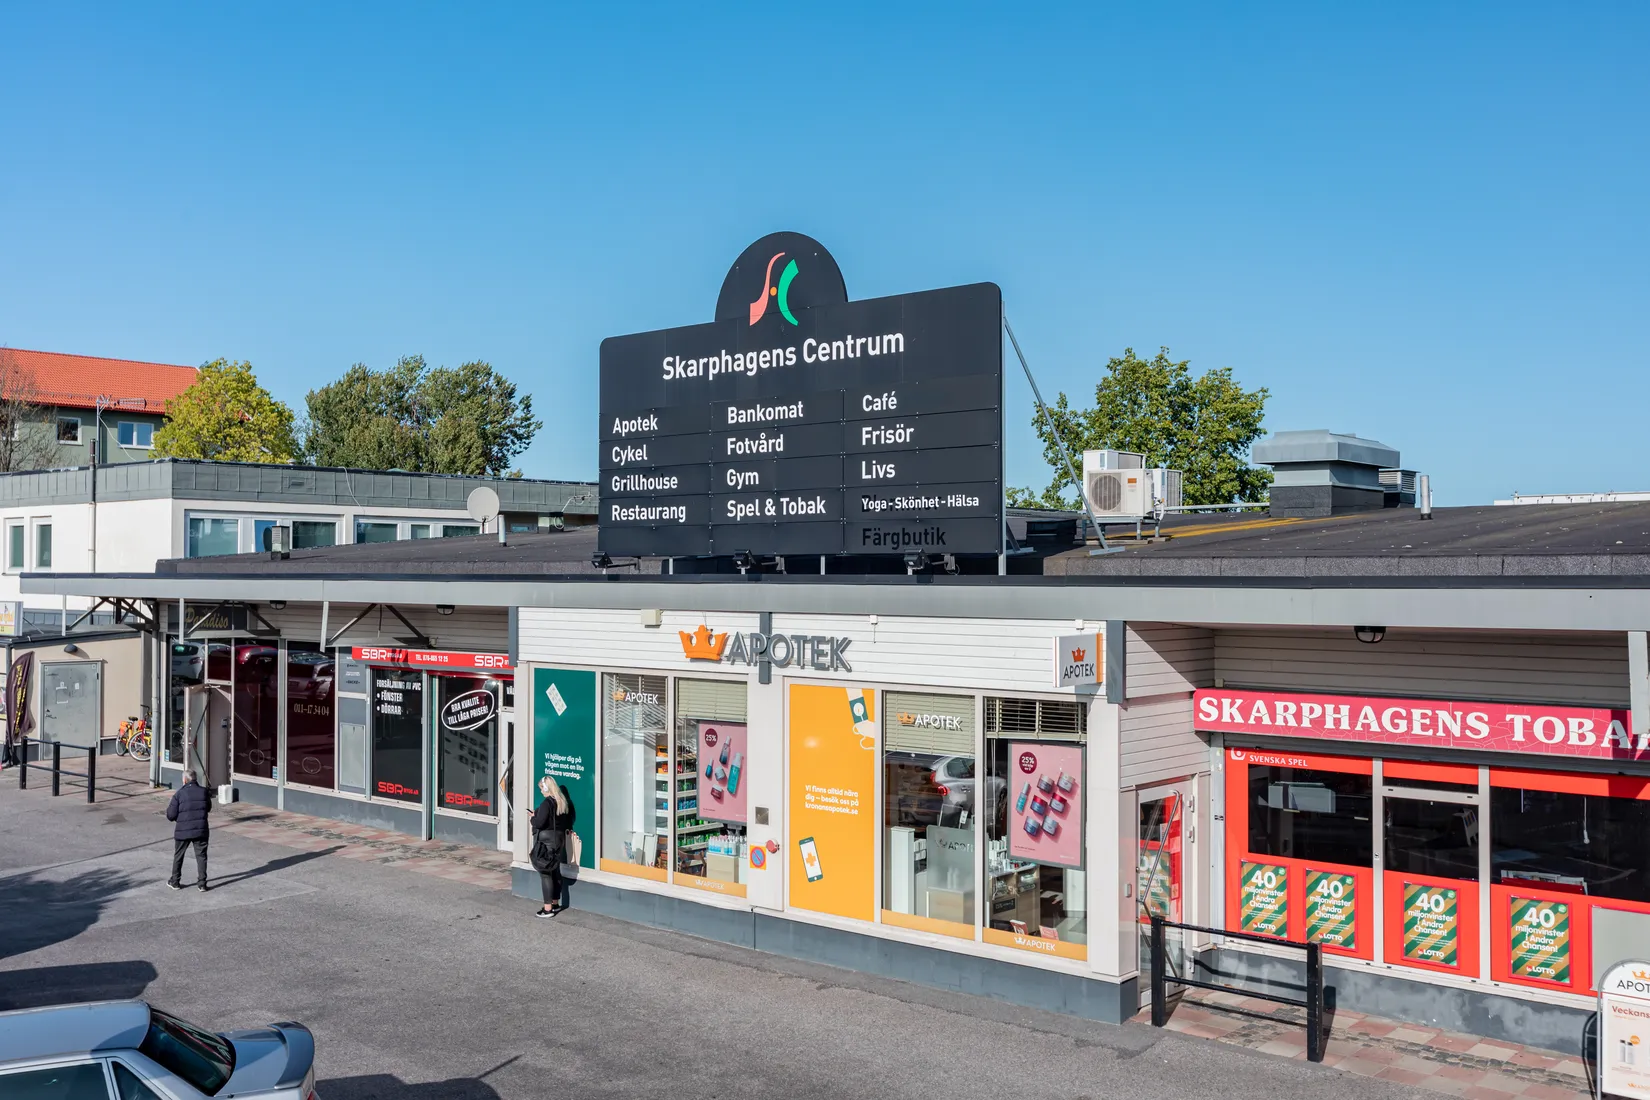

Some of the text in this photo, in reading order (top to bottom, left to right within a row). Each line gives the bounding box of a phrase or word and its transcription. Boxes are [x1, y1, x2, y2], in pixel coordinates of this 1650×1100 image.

[662, 332, 904, 380] Skarphagens Centrum
[862, 391, 897, 411] Café
[727, 401, 803, 424] Bankomat
[612, 414, 658, 437] Apotek
[862, 424, 914, 446] Frisör
[727, 432, 784, 455] Fotvård
[612, 444, 648, 466] Cykel
[861, 460, 896, 479] Livs
[611, 474, 678, 491] Grillhouse
[726, 468, 759, 490] Gym
[611, 505, 686, 523] Restaurang
[727, 496, 826, 521] Spel & Tobak
[862, 527, 946, 550] Färgbutik
[361, 648, 387, 660] SBR
[727, 631, 852, 673] APOTEK
[474, 655, 504, 667] SBR
[1063, 663, 1095, 679] APOTEK
[412, 682, 421, 691] PVC
[381, 690, 403, 702] FÖNSTER
[625, 691, 658, 704] APOTEK
[381, 703, 402, 715] DÖRRAR
[451, 703, 460, 713] BRA
[448, 705, 489, 725] TILL LÅGA PRISER!
[915, 714, 960, 728] APOTEK
[1199, 697, 1490, 739] SKARPHAGENS
[705, 734, 717, 742] 25%
[550, 753, 566, 761] hjälper
[575, 756, 582, 764] på
[1021, 756, 1035, 765] 25%
[1249, 755, 1308, 767] SVENSKA SPEL
[545, 768, 562, 776] friskare
[377, 781, 403, 795] SBR
[812, 785, 826, 793] finns
[445, 791, 473, 806] SBR
[805, 793, 814, 802] dig
[821, 795, 839, 803] besök
[850, 799, 859, 807] på
[805, 802, 858, 814] kronansapotek.se
[703, 880, 725, 889] APOTEK
[1251, 870, 1276, 888] 40
[1244, 886, 1284, 897] miljonvinster
[1316, 879, 1343, 898] 40
[1249, 900, 1279, 910] Chansen!
[1256, 895, 1275, 903] Andra
[1309, 896, 1351, 907] miljonvinster
[1415, 893, 1445, 912] 40
[1322, 904, 1342, 913] Andra
[1315, 910, 1346, 920] Chansen!
[1408, 910, 1453, 921] miljonvinster
[1523, 907, 1555, 928] 40
[1257, 922, 1276, 930] LOTTO
[1422, 919, 1444, 928] Andra
[1414, 925, 1447, 936] Chansen!
[1515, 925, 1565, 937] miljonvinster
[1323, 933, 1343, 941] LOTTO
[1530, 935, 1554, 944] Andra
[1026, 940, 1056, 951] APOTEK
[1522, 940, 1558, 952] Chansen!
[1423, 949, 1445, 958] LOTTO
[1532, 966, 1555, 974] LOTTO
